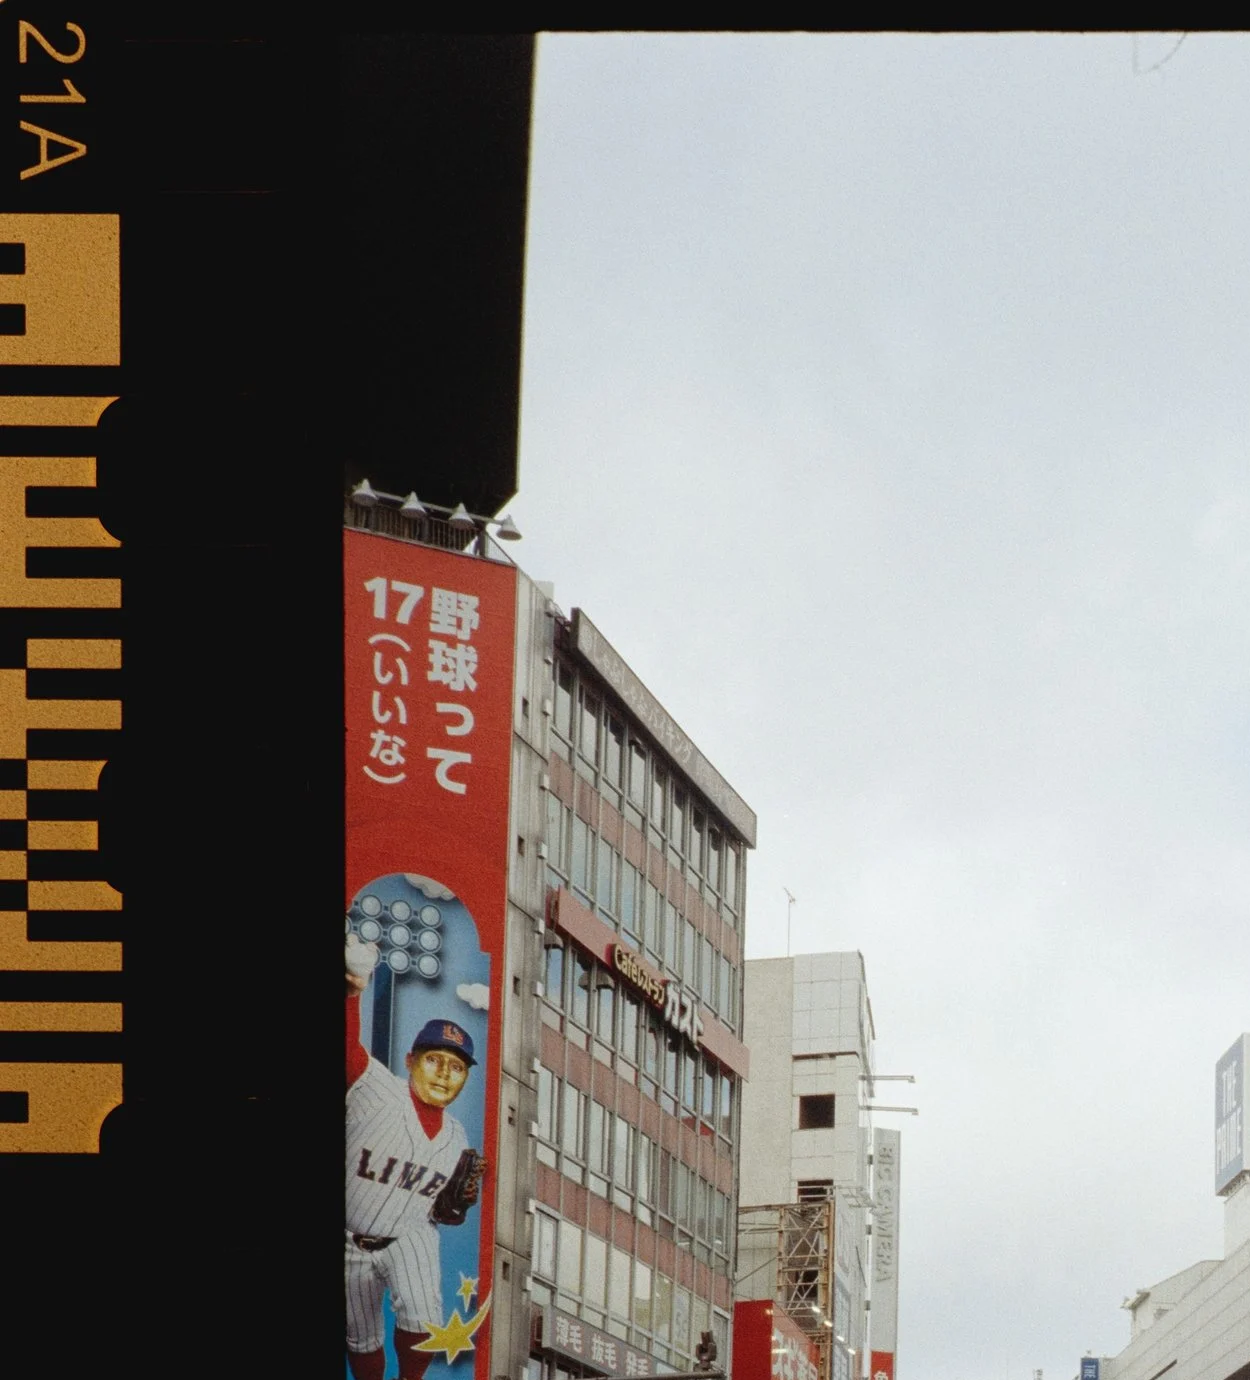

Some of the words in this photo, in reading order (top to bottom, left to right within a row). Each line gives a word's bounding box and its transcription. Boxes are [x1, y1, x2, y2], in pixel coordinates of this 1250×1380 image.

[18, 20, 87, 181] 21A
[426, 587, 480, 794] 野球って
[665, 980, 705, 1046] ガスト
[357, 1148, 448, 1199] LIVE
[877, 1146, 895, 1181] BIC
[876, 1186, 894, 1283] CAMERA
